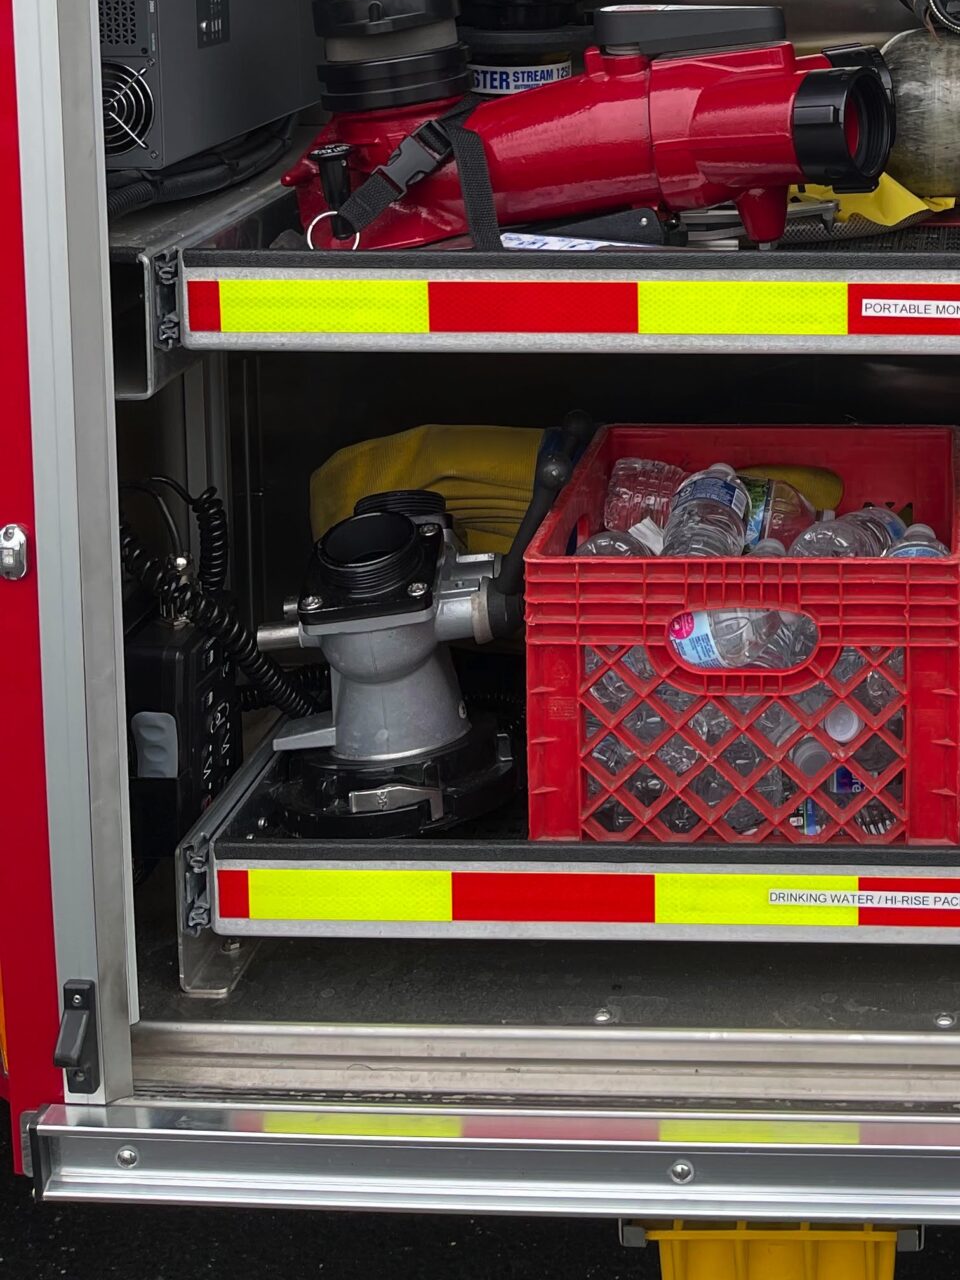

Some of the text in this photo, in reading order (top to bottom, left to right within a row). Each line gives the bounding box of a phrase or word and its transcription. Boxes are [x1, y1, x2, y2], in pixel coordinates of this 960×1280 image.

[512, 69, 554, 83] STREAM
[864, 302, 932, 316] PORTABLE
[769, 892, 828, 904] DRINKING
[830, 894, 875, 905] WATER
[884, 895, 930, 907] HI-RISE
